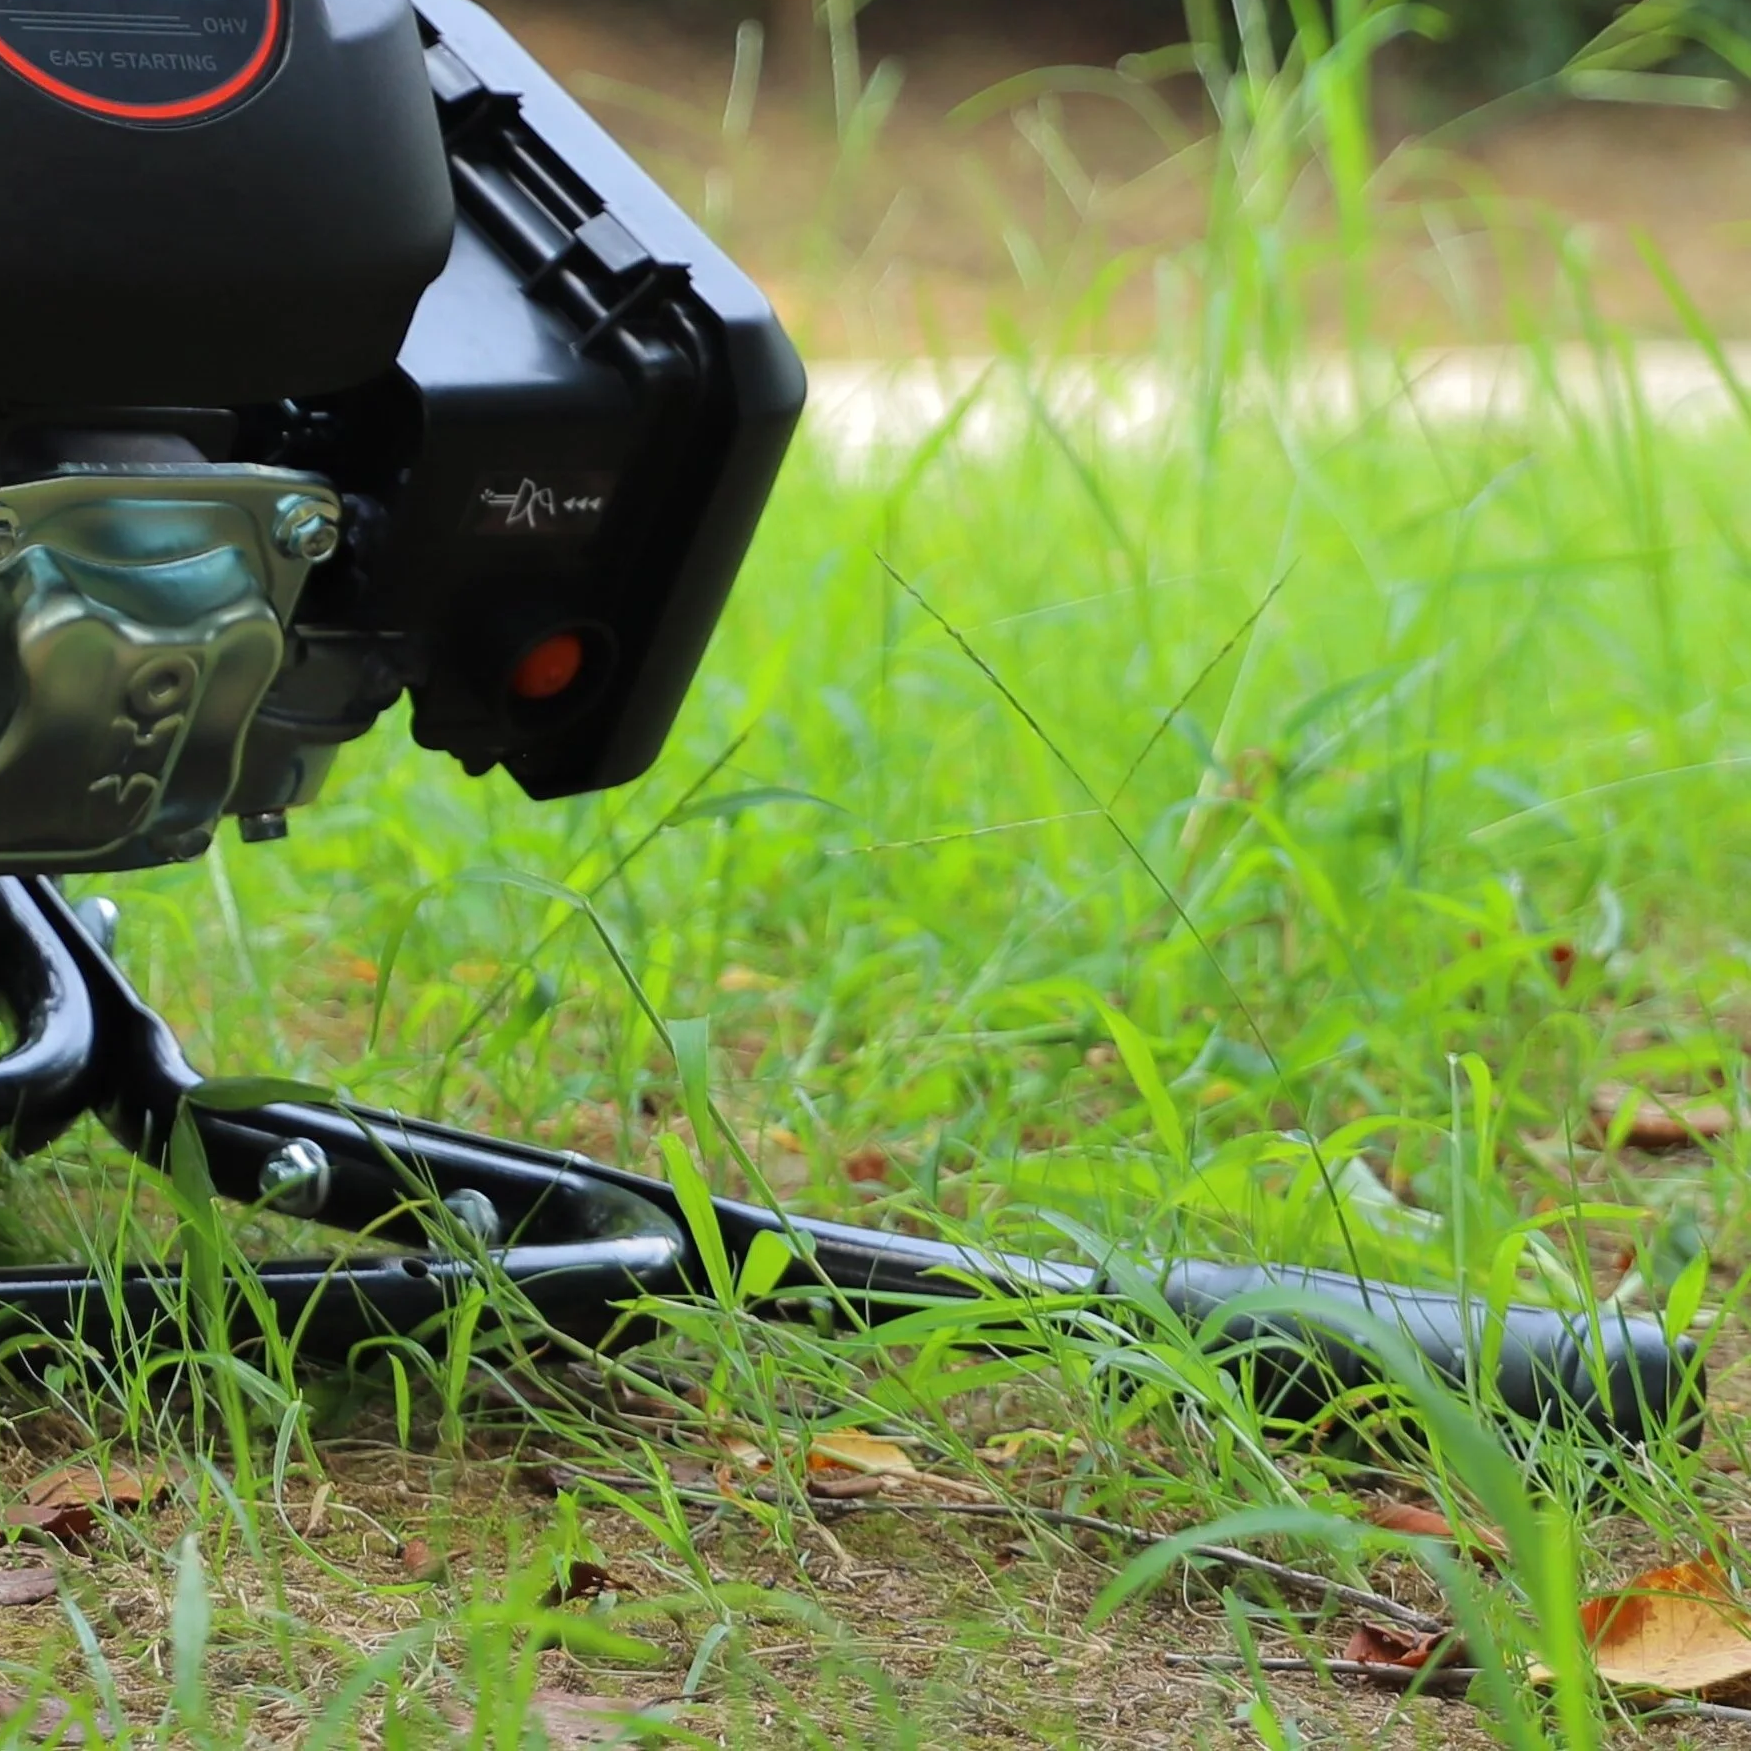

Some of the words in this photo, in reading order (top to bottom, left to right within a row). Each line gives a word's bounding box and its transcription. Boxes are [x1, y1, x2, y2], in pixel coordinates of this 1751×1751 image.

[202, 16, 248, 34] OHV
[48, 49, 105, 69] EASY
[110, 52, 217, 72] STARTING
